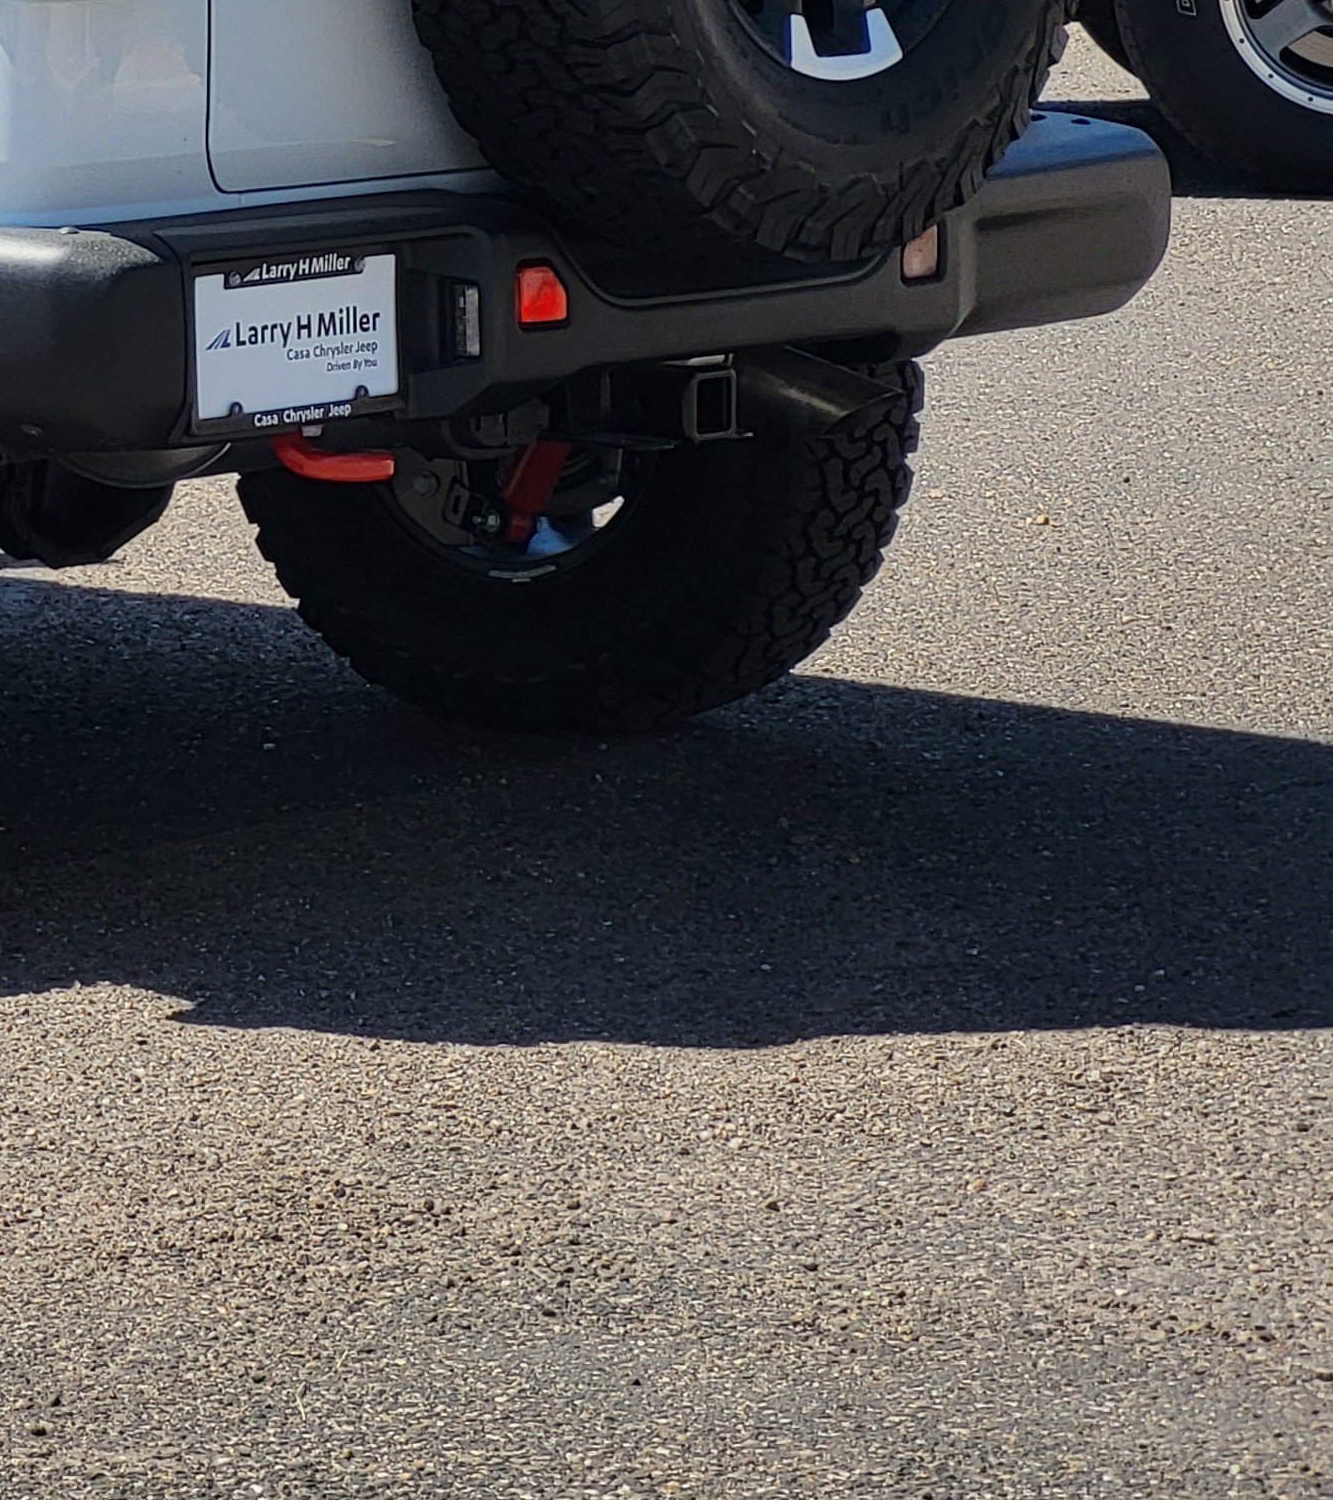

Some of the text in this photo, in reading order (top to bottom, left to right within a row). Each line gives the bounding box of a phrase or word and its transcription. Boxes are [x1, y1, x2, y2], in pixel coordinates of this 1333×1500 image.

[261, 253, 351, 280] Larry H Miller
[235, 305, 381, 349] Larry H Miller
[286, 341, 378, 361] Casa Chrysler Jeep
[327, 358, 378, 373] Driven By You
[254, 403, 352, 428] Casa Chrysler Jeep
